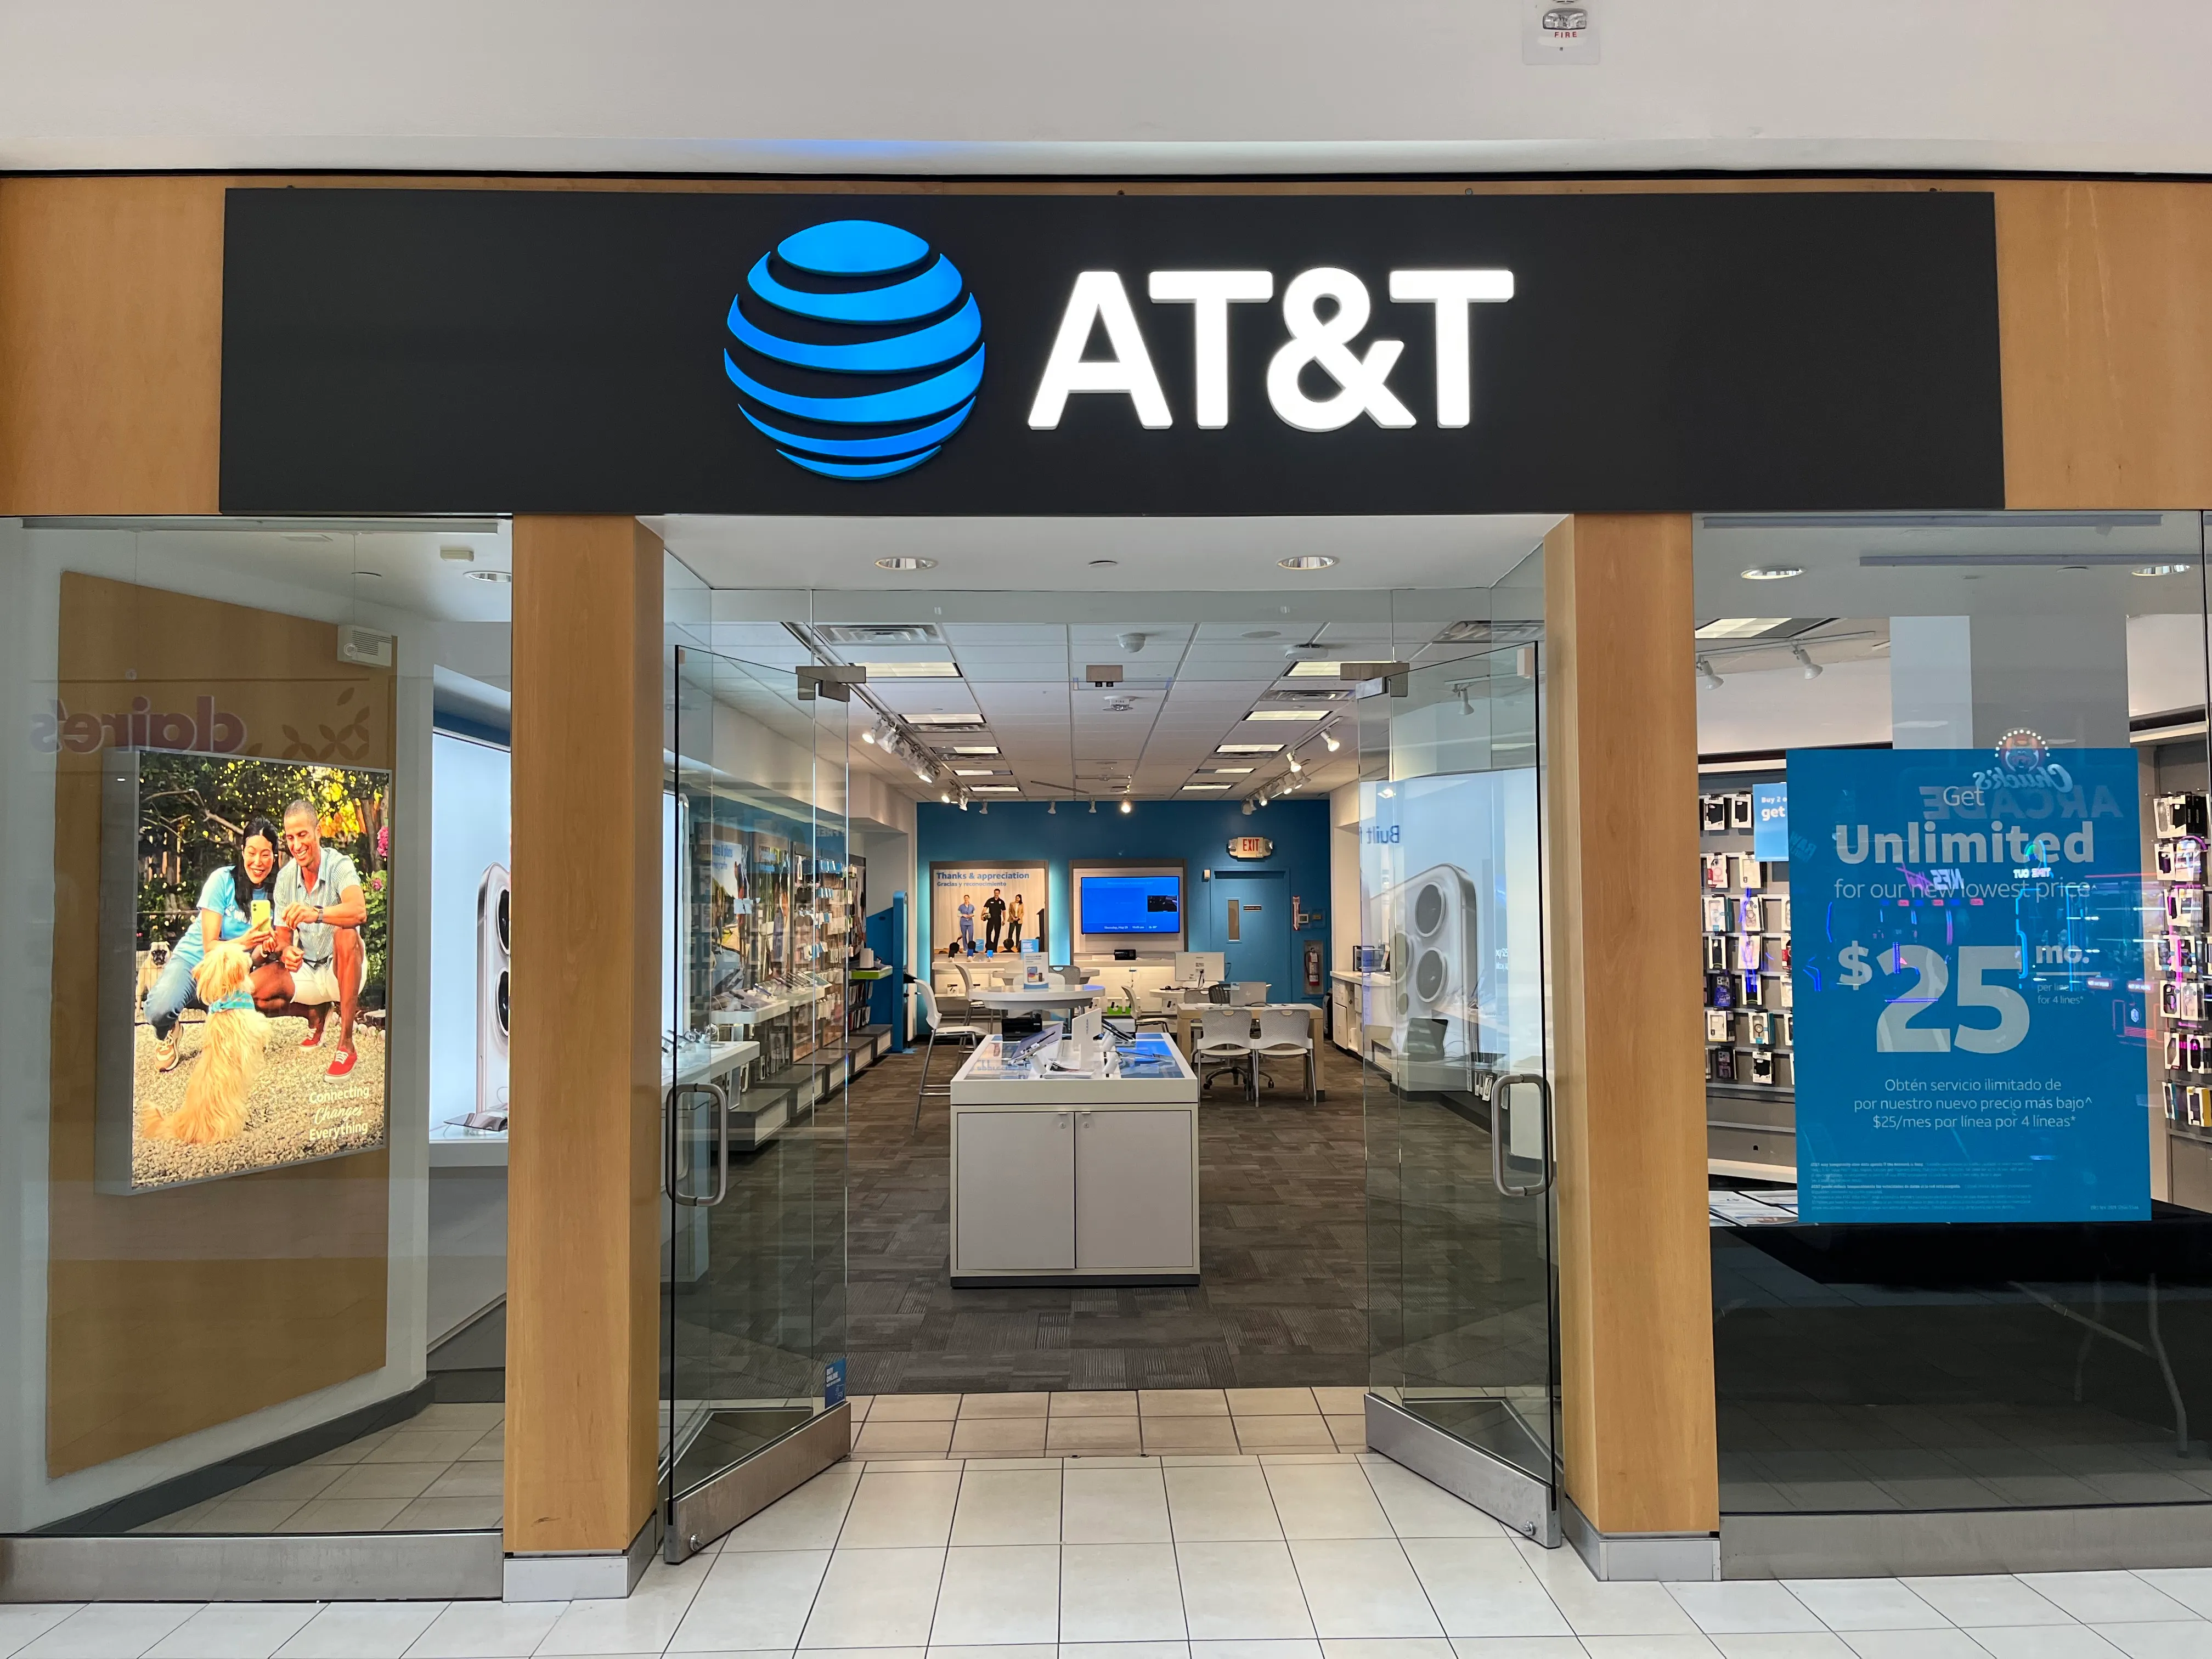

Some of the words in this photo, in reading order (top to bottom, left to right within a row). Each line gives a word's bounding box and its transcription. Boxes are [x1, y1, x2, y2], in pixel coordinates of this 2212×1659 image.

[1028, 267, 1514, 432] AT&T
[1943, 786, 1985, 806] Get
[1762, 806, 1786, 821] get
[1243, 839, 1260, 851] EXIT
[1836, 821, 2094, 865] Unlimited
[977, 872, 1030, 881] appreciation
[1835, 879, 1864, 898] for
[1870, 883, 1905, 898] our
[1912, 883, 1955, 898] new
[1961, 879, 2030, 898] lowest
[2036, 945, 2090, 964] mo.
[2037, 984, 2052, 993] per
[2038, 995, 2050, 1004] for
[1885, 1079, 1927, 1091] Obtén
[1931, 1079, 1981, 1091] servicio
[1985, 1079, 2041, 1091] ilimitado
[2045, 1079, 2062, 1091] de
[309, 1086, 370, 1104] Connecting
[1854, 1100, 1877, 1113] por
[1881, 1098, 1932, 1110] nuestro
[1936, 1099, 1977, 1110] nuevo
[1980, 1097, 2022, 1112] precio
[2025, 1096, 2053, 1109] más
[314, 1104, 364, 1125] Changes
[1873, 1114, 1932, 1130] $25/mes
[1935, 1118, 1957, 1130] por
[1961, 1115, 1991, 1127] línea
[1995, 1118, 2018, 1130] por
[2021, 1116, 2030, 1127] 4
[309, 1121, 368, 1141] Everything
